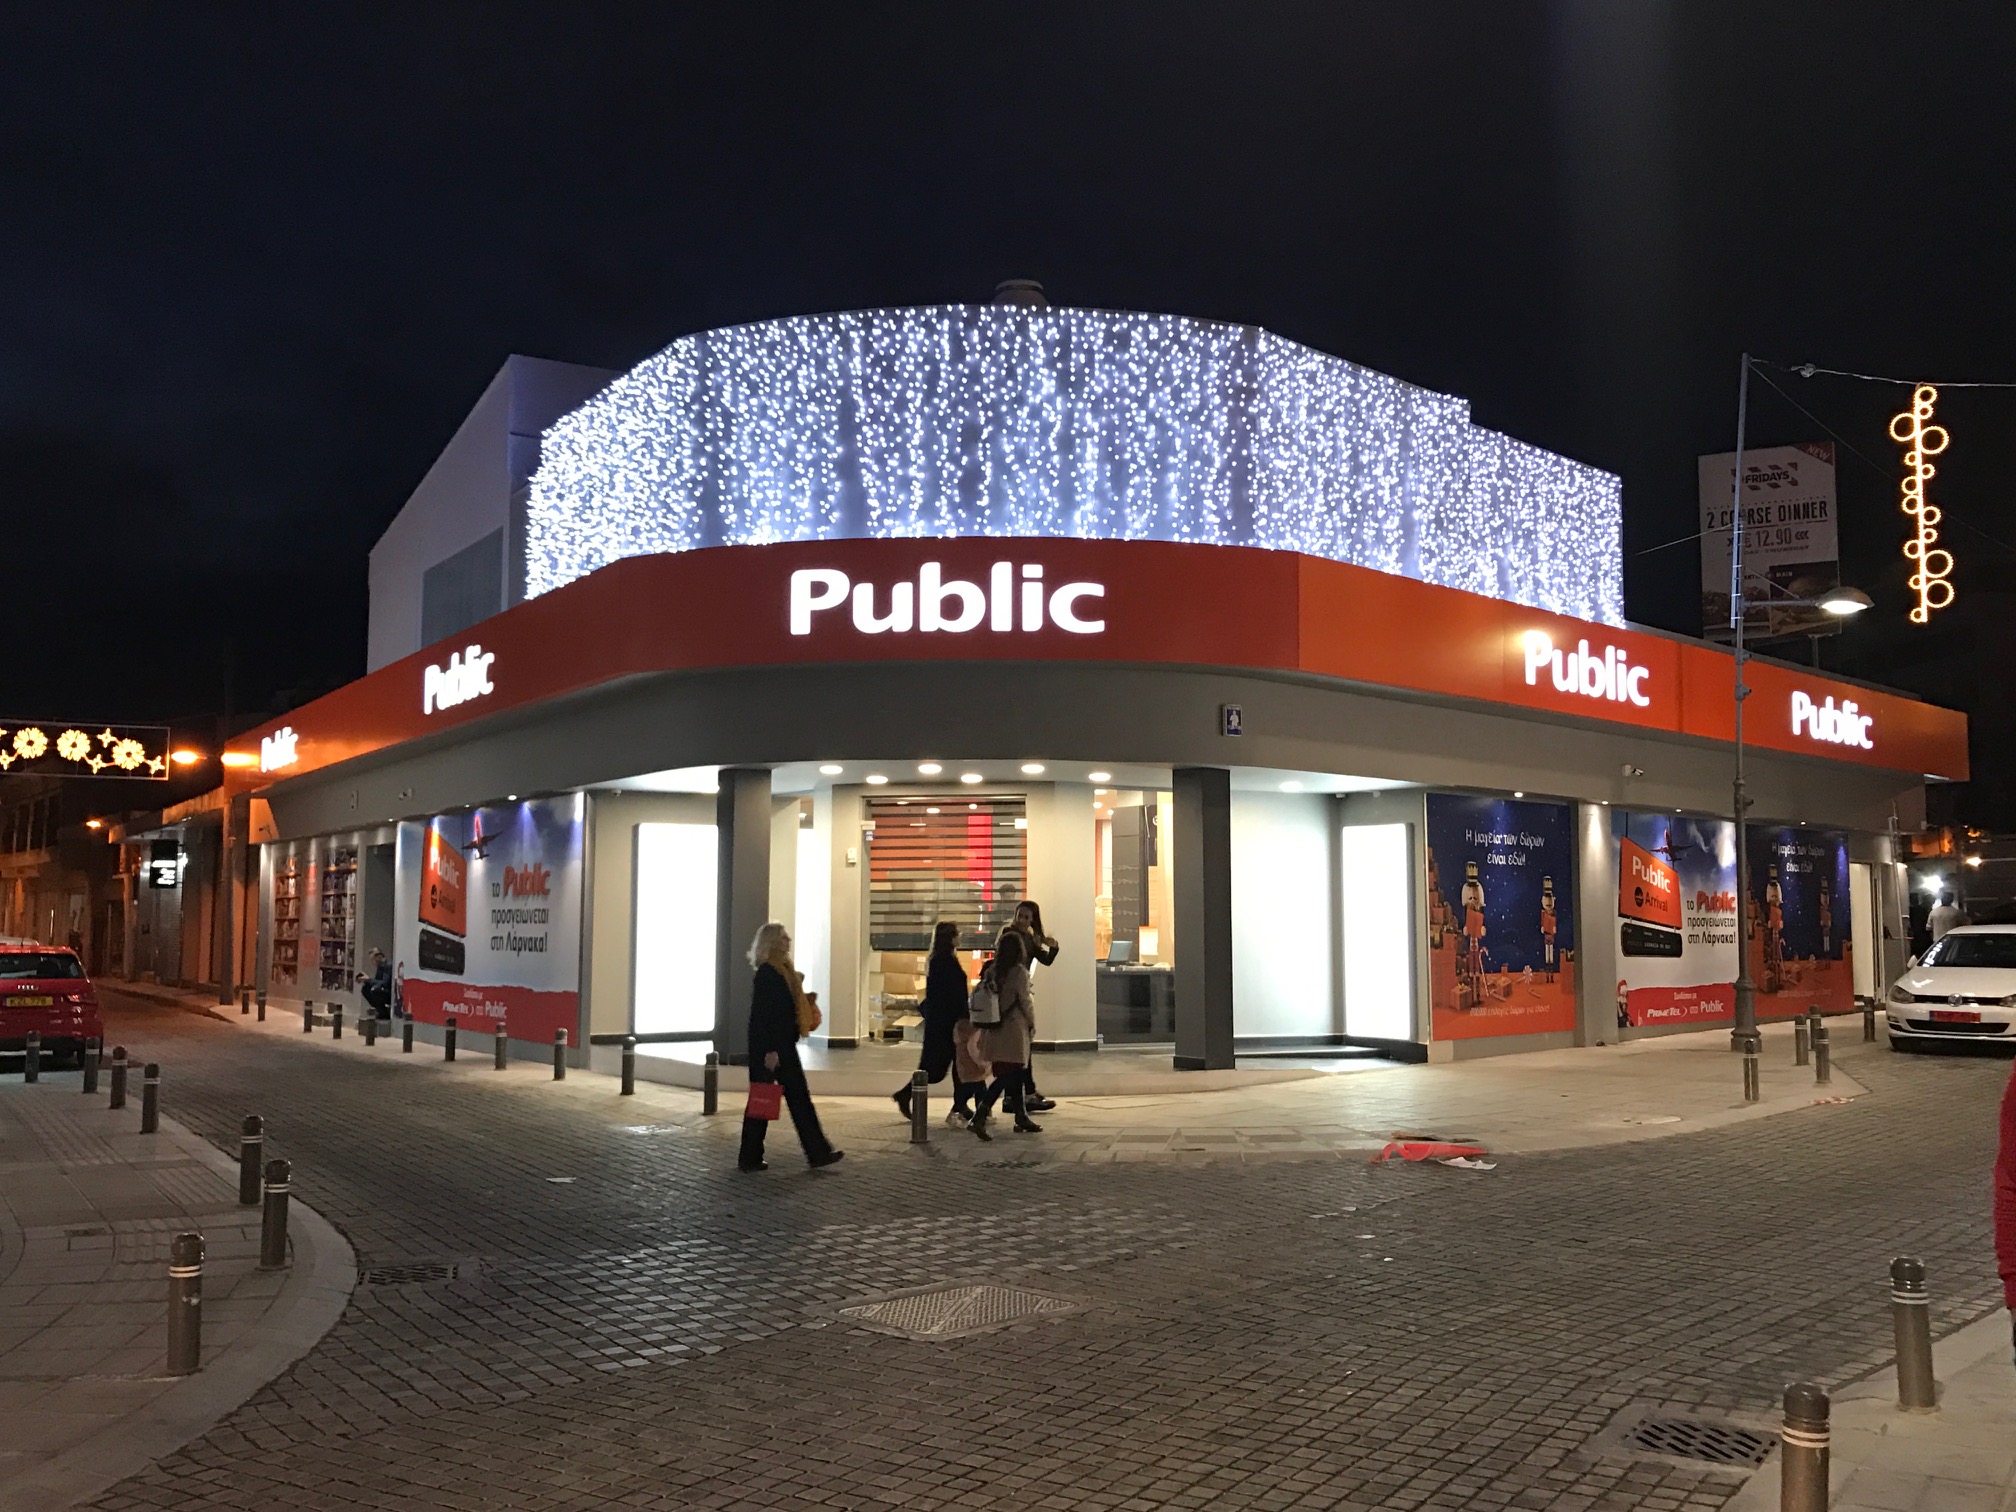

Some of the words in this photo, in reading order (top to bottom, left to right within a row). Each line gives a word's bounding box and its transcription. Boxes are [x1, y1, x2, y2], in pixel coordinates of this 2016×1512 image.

[1807, 446, 1830, 460] NEW
[1745, 471, 1790, 484] FRIDAYS
[1707, 511, 1714, 528] 2
[1721, 506, 1771, 526] CORSE
[1778, 501, 1828, 522] DINNER
[1755, 528, 1792, 547] 12.90
[791, 561, 1104, 635] Public
[424, 645, 495, 714] Public
[1524, 630, 1650, 706] Public
[1792, 690, 1873, 749] Public
[430, 846, 460, 889] Public
[492, 882, 501, 897] το
[503, 862, 551, 897] Public
[1632, 855, 1671, 893] Public
[1645, 892, 1668, 912] Arrival
[1686, 900, 1694, 910] το
[1696, 891, 1736, 913] Public
[491, 903, 549, 929] προσγειώνεται
[490, 936, 504, 951] στη
[505, 931, 548, 957] Λάρνακα!
[1688, 933, 1700, 944] στη
[1700, 931, 1736, 947] Λάρνακα!
[1700, 999, 1724, 1013] Public
